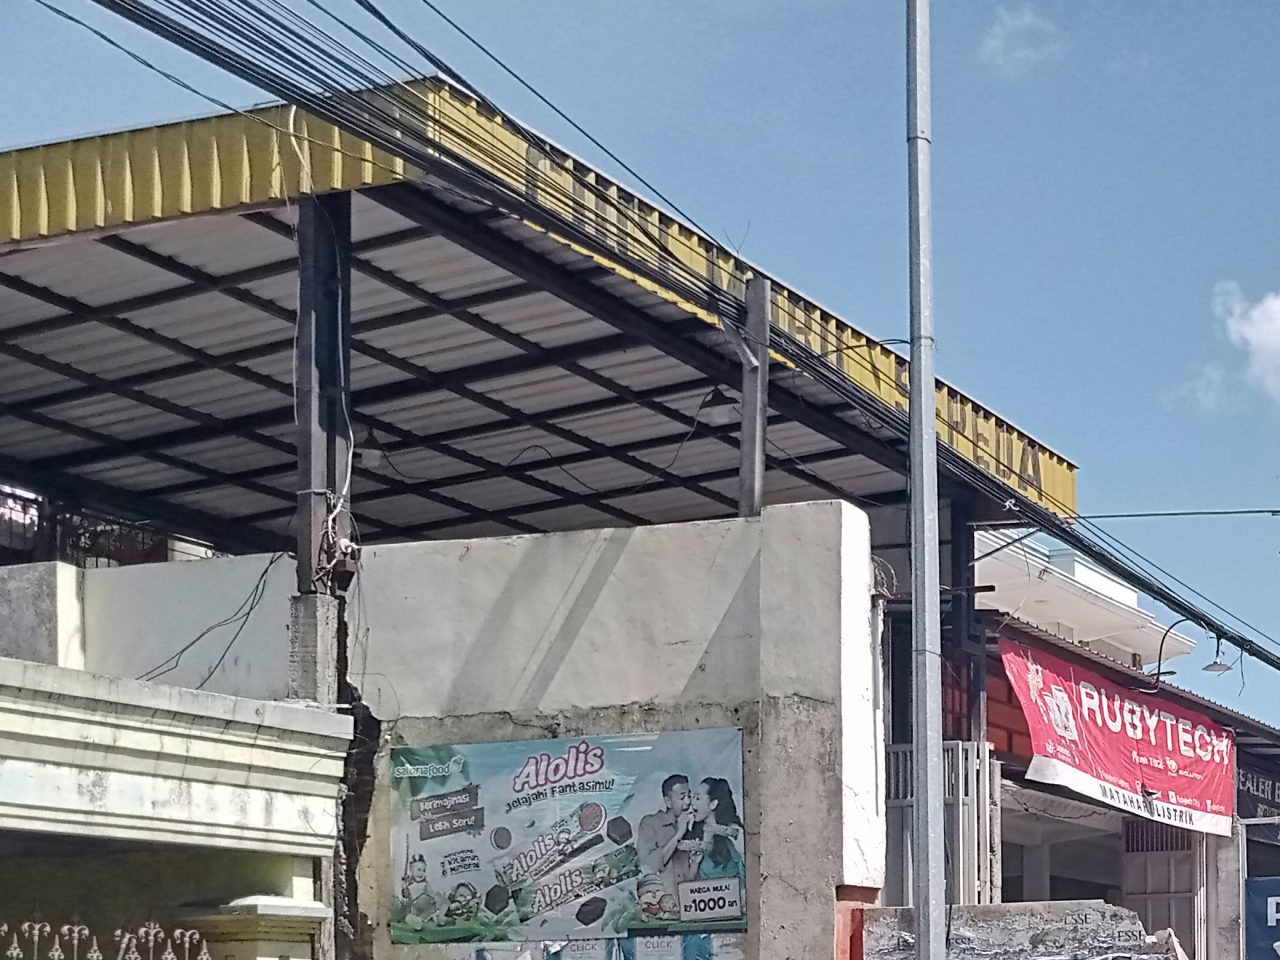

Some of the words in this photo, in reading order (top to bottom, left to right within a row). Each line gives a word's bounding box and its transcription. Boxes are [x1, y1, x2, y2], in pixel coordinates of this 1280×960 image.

[895, 352, 1043, 503] SPEDA
[1079, 681, 1232, 766] RUBYTECH
[513, 741, 605, 793] Alolis
[1238, 768, 1272, 801] EALER
[505, 789, 548, 814] Jelajahi
[1099, 783, 1155, 819] MATAHAR
[1156, 804, 1194, 826] LISTRIK
[511, 833, 555, 881] Alolis
[532, 868, 584, 913] Alolis
[570, 942, 598, 952] CLICK
[644, 938, 673, 949] CLICK
